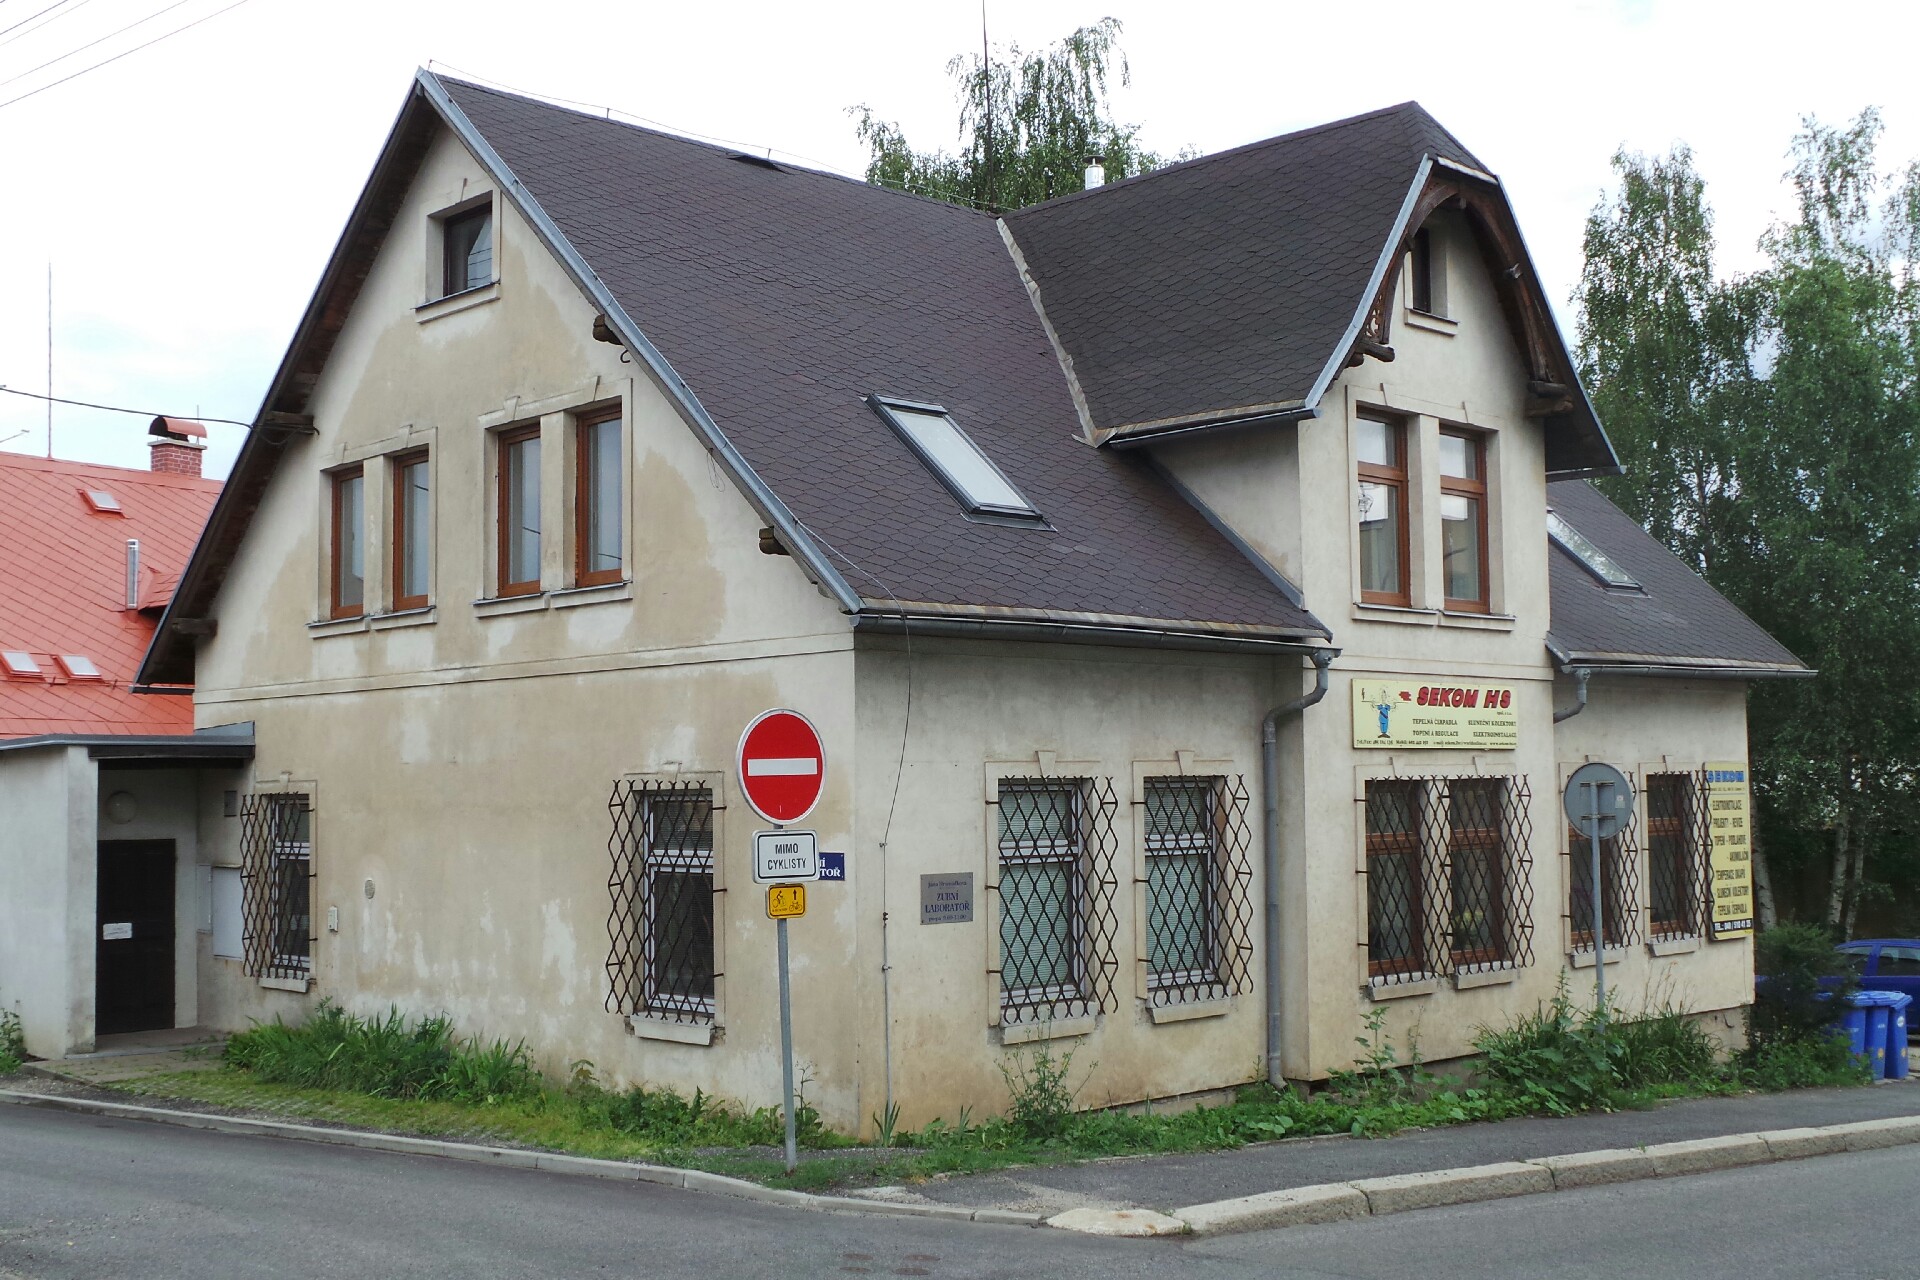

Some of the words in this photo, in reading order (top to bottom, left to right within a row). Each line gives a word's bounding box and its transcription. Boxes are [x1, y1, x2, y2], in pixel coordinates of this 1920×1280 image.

[1417, 686, 1479, 708] SEKOM
[1483, 689, 1511, 709] HS
[1707, 770, 1745, 783] SEKOM
[775, 843, 799, 855] MIMO
[767, 857, 807, 870] CYKLISTY
[937, 889, 959, 901] ZUBNÍ
[925, 900, 970, 913] LABORATOŘ
